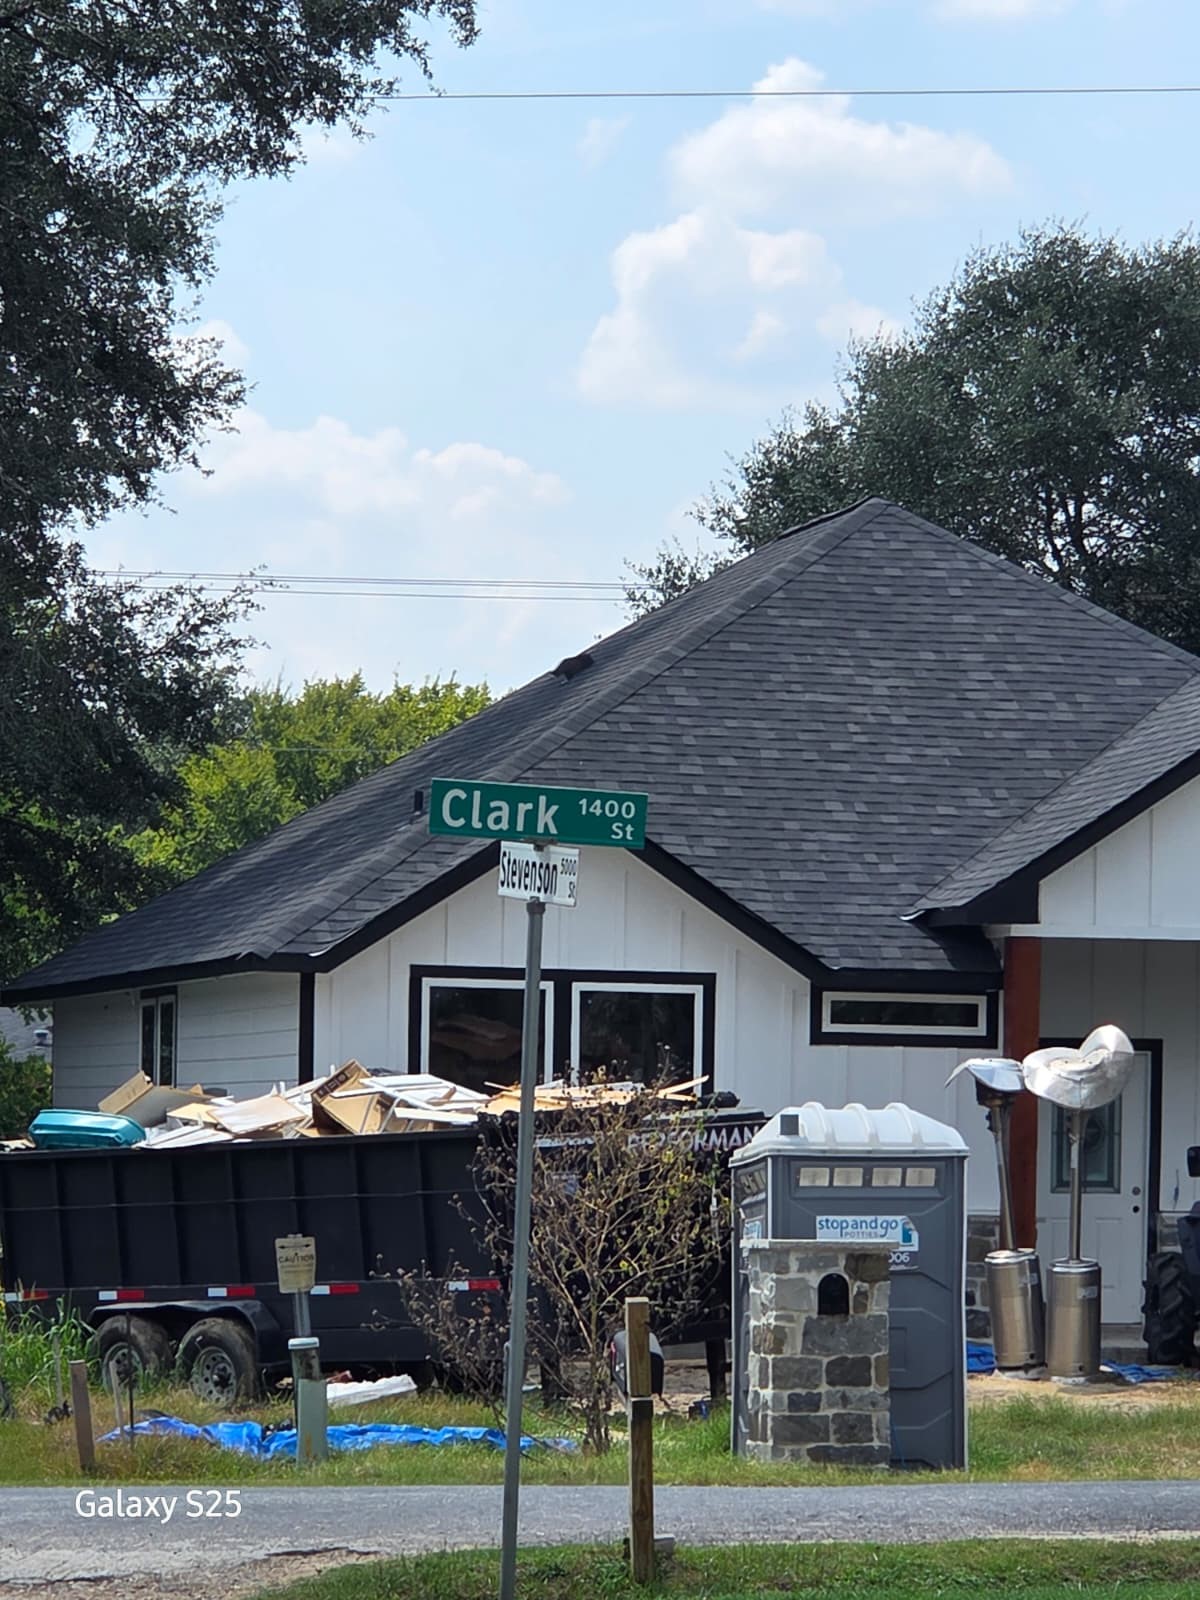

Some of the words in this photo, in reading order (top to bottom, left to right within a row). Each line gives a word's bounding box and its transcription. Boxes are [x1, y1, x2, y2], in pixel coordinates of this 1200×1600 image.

[441, 788, 560, 834] Clark
[578, 798, 636, 818] 1400
[610, 822, 635, 840] St
[500, 850, 558, 896] Stevenson
[567, 881, 576, 898] St
